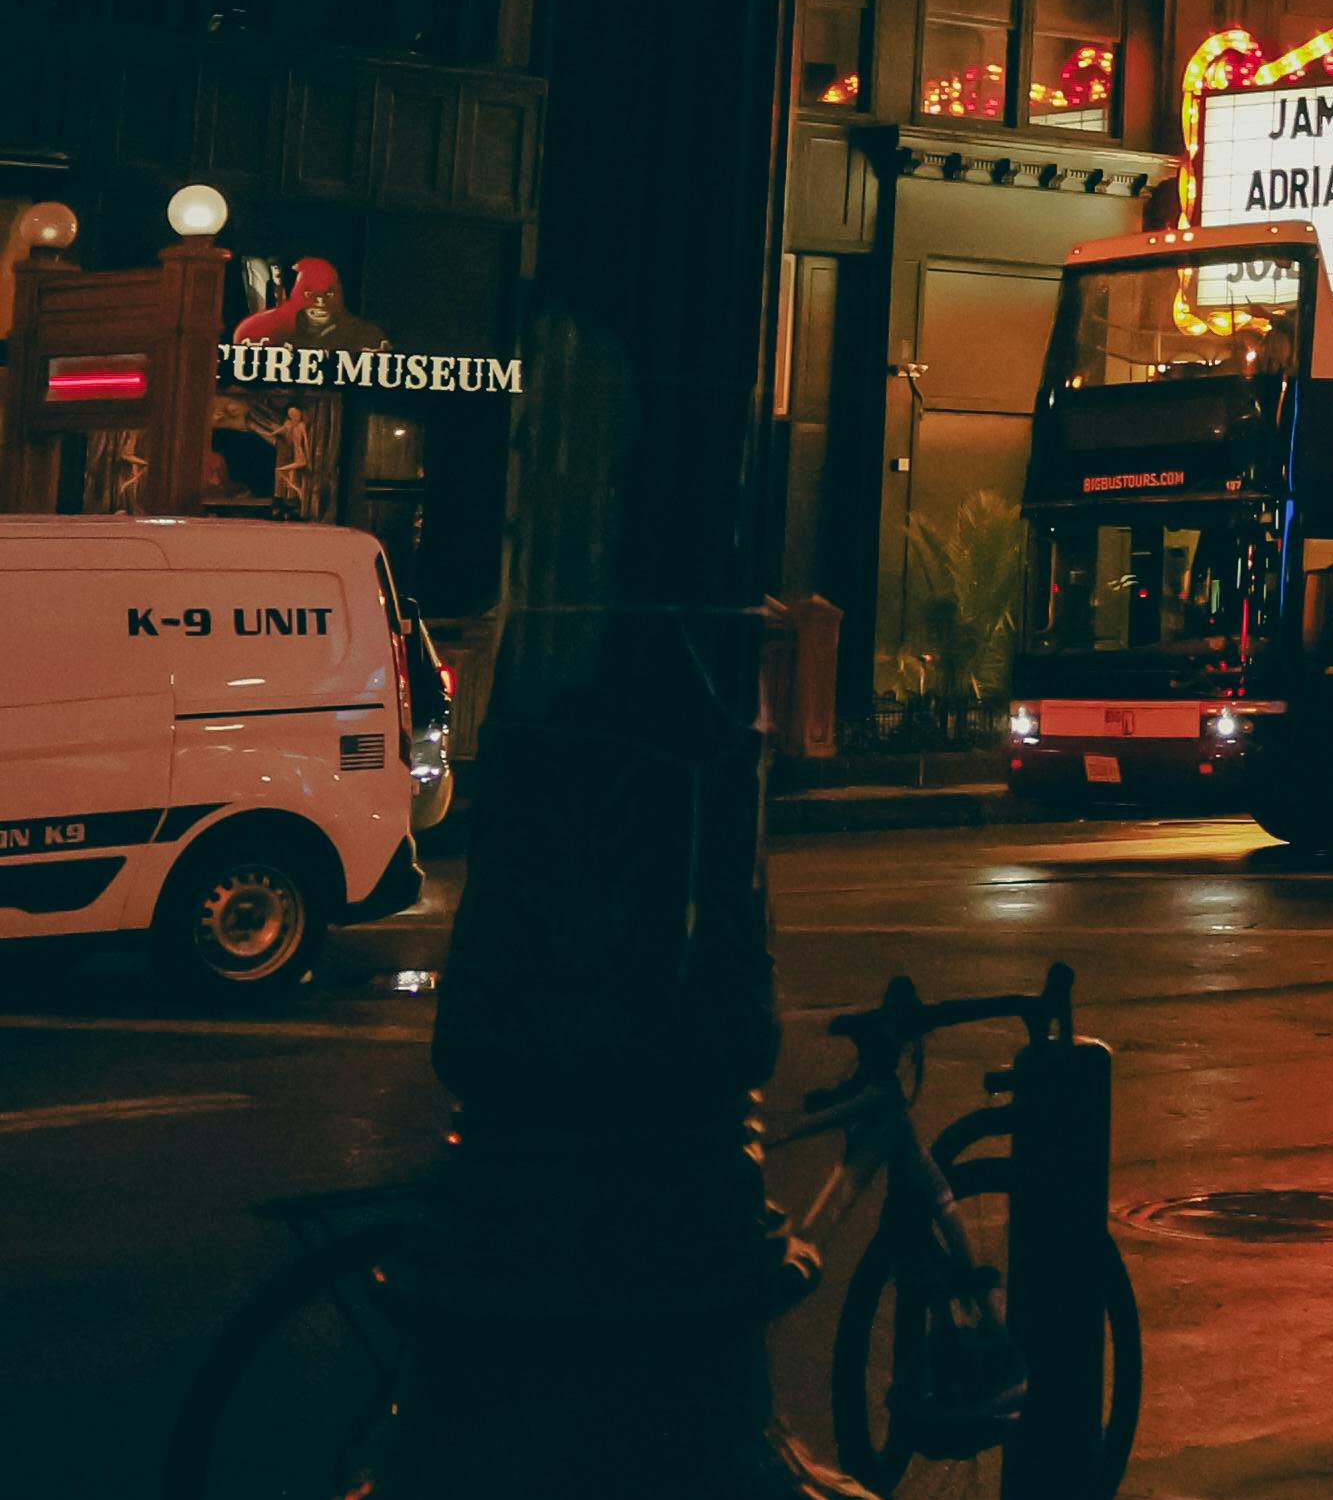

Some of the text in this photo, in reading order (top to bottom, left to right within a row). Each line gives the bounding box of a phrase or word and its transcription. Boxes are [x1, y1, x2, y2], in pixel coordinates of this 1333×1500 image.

[334, 350, 523, 393] MUSEUM
[1083, 471, 1184, 492] BIGBUSTOURS.COM
[128, 608, 332, 636] K-9 UNIT
[44, 823, 86, 846] K9
